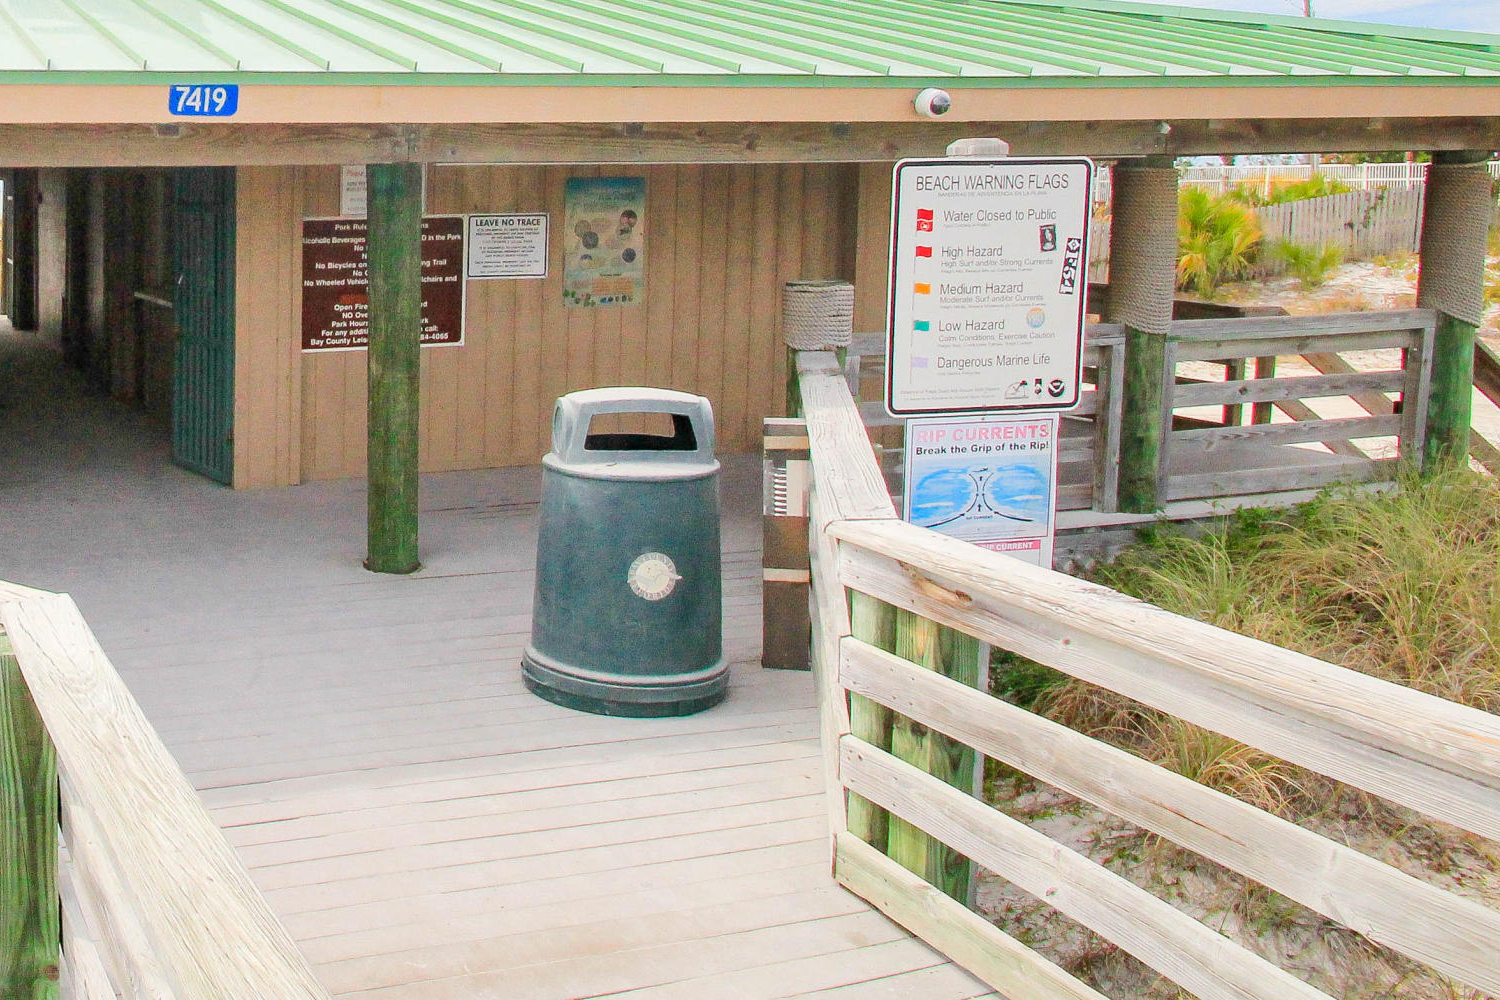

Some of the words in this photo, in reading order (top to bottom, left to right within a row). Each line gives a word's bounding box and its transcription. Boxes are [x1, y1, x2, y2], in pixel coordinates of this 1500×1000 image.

[176, 86, 227, 112] 7419
[916, 175, 960, 191] BEACH
[964, 174, 1024, 190] WARNING
[1028, 173, 1069, 189] FLAGS
[943, 210, 974, 222] Water
[976, 209, 1012, 222] Closed
[1015, 209, 1025, 221] to
[1027, 208, 1057, 220] Public
[475, 218, 499, 227] LEAVE
[501, 218, 515, 226] NO
[517, 218, 541, 226] TRACE
[941, 246, 964, 260] High
[966, 245, 1003, 257] Hazard
[315, 262, 326, 270] No
[327, 261, 357, 270] Bicycles
[433, 258, 447, 266] Trail
[941, 261, 957, 269] High
[999, 258, 1023, 268] Strong
[1024, 258, 1054, 266] Currents
[304, 279, 314, 287] No
[316, 278, 346, 287] Wheeled
[940, 283, 982, 295] Medium
[985, 282, 1024, 294] Hazard
[940, 295, 973, 304] Moderate
[975, 294, 990, 303] Surf
[1014, 293, 1044, 302] Currents
[334, 303, 353, 312] Open
[331, 320, 348, 328] Park
[938, 319, 962, 332] Low
[965, 318, 1005, 331] Hazard
[321, 329, 333, 337] For
[335, 329, 348, 337] any
[938, 333, 957, 342] Calm
[998, 331, 1028, 341] Exercise
[1029, 330, 1056, 340] Caution
[310, 337, 324, 346] Bay
[326, 335, 351, 345] County
[937, 355, 993, 371] Dangerous
[996, 353, 1030, 367] Marine
[1032, 352, 1051, 365] Life
[916, 428, 947, 443] RIP
[952, 423, 1050, 442] CURRENTS
[916, 445, 947, 456] Break
[950, 444, 967, 454] the
[970, 443, 992, 454] Grip
[995, 441, 1006, 451] of
[1009, 442, 1026, 451] the
[1030, 440, 1049, 450] Rip!
[996, 541, 1033, 551] CURRENT
